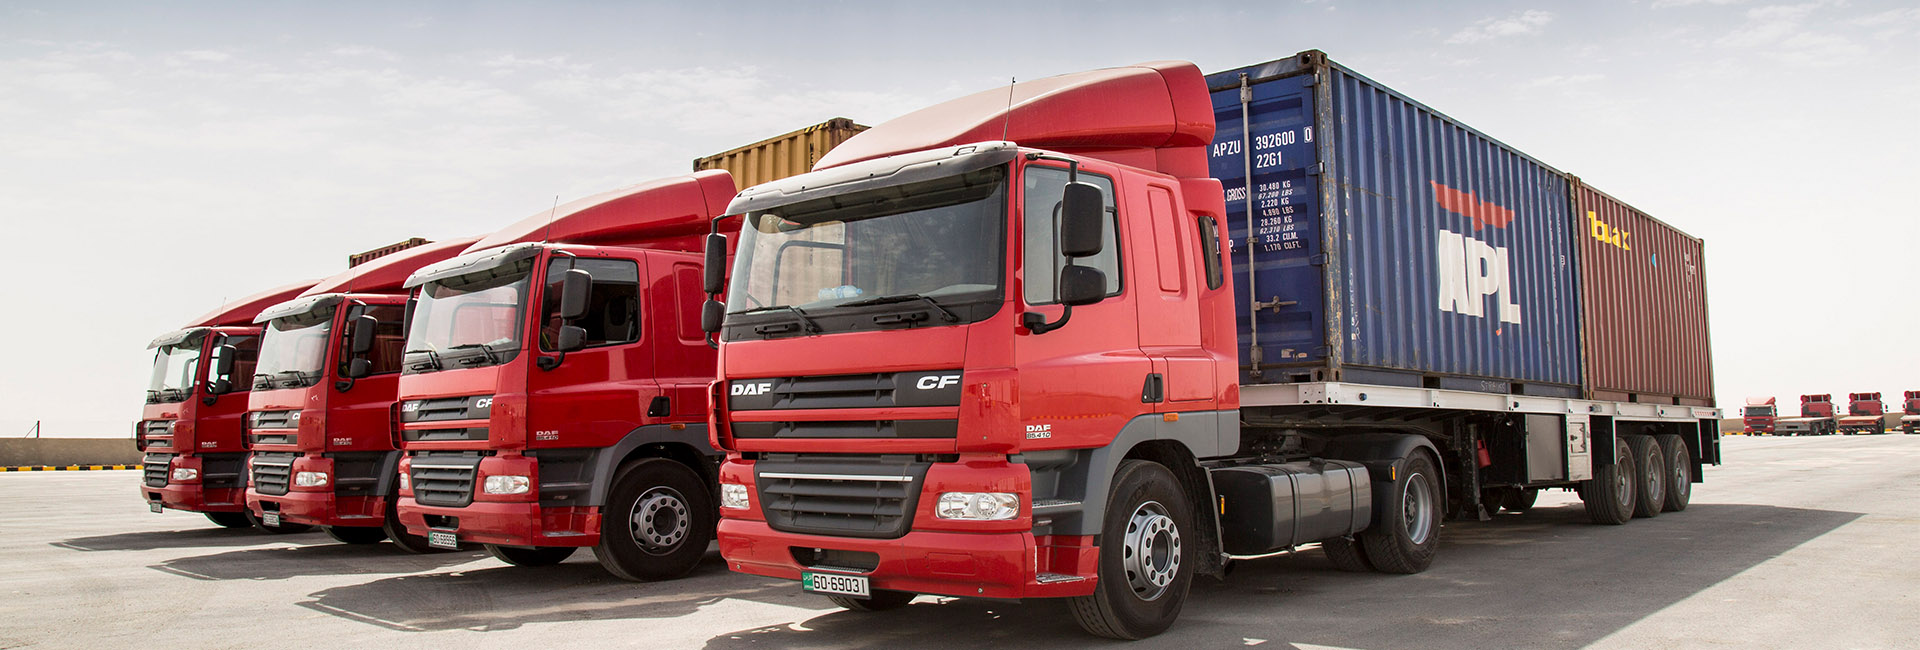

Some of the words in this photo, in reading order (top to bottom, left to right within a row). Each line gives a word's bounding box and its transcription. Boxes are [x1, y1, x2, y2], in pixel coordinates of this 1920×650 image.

[1213, 140, 1241, 158] APZU
[1255, 130, 1295, 150] 392600
[1256, 151, 1282, 169] 22G1
[1259, 182, 1280, 192] 30.480
[1282, 180, 1291, 188] KG
[1258, 191, 1280, 200] 67.200
[1261, 199, 1278, 208] 2.220
[1281, 197, 1290, 205] KG
[1282, 206, 1294, 214] LBS
[1261, 217, 1281, 226] 28.260
[1284, 216, 1292, 224] KG
[1260, 226, 1280, 234] 62.310
[1266, 234, 1280, 242] 33.2
[1264, 243, 1281, 252] 1.170
[1439, 230, 1521, 324] APL
[916, 375, 960, 390] CF
[730, 383, 772, 396] DAF
[402, 404, 418, 412] DAF
